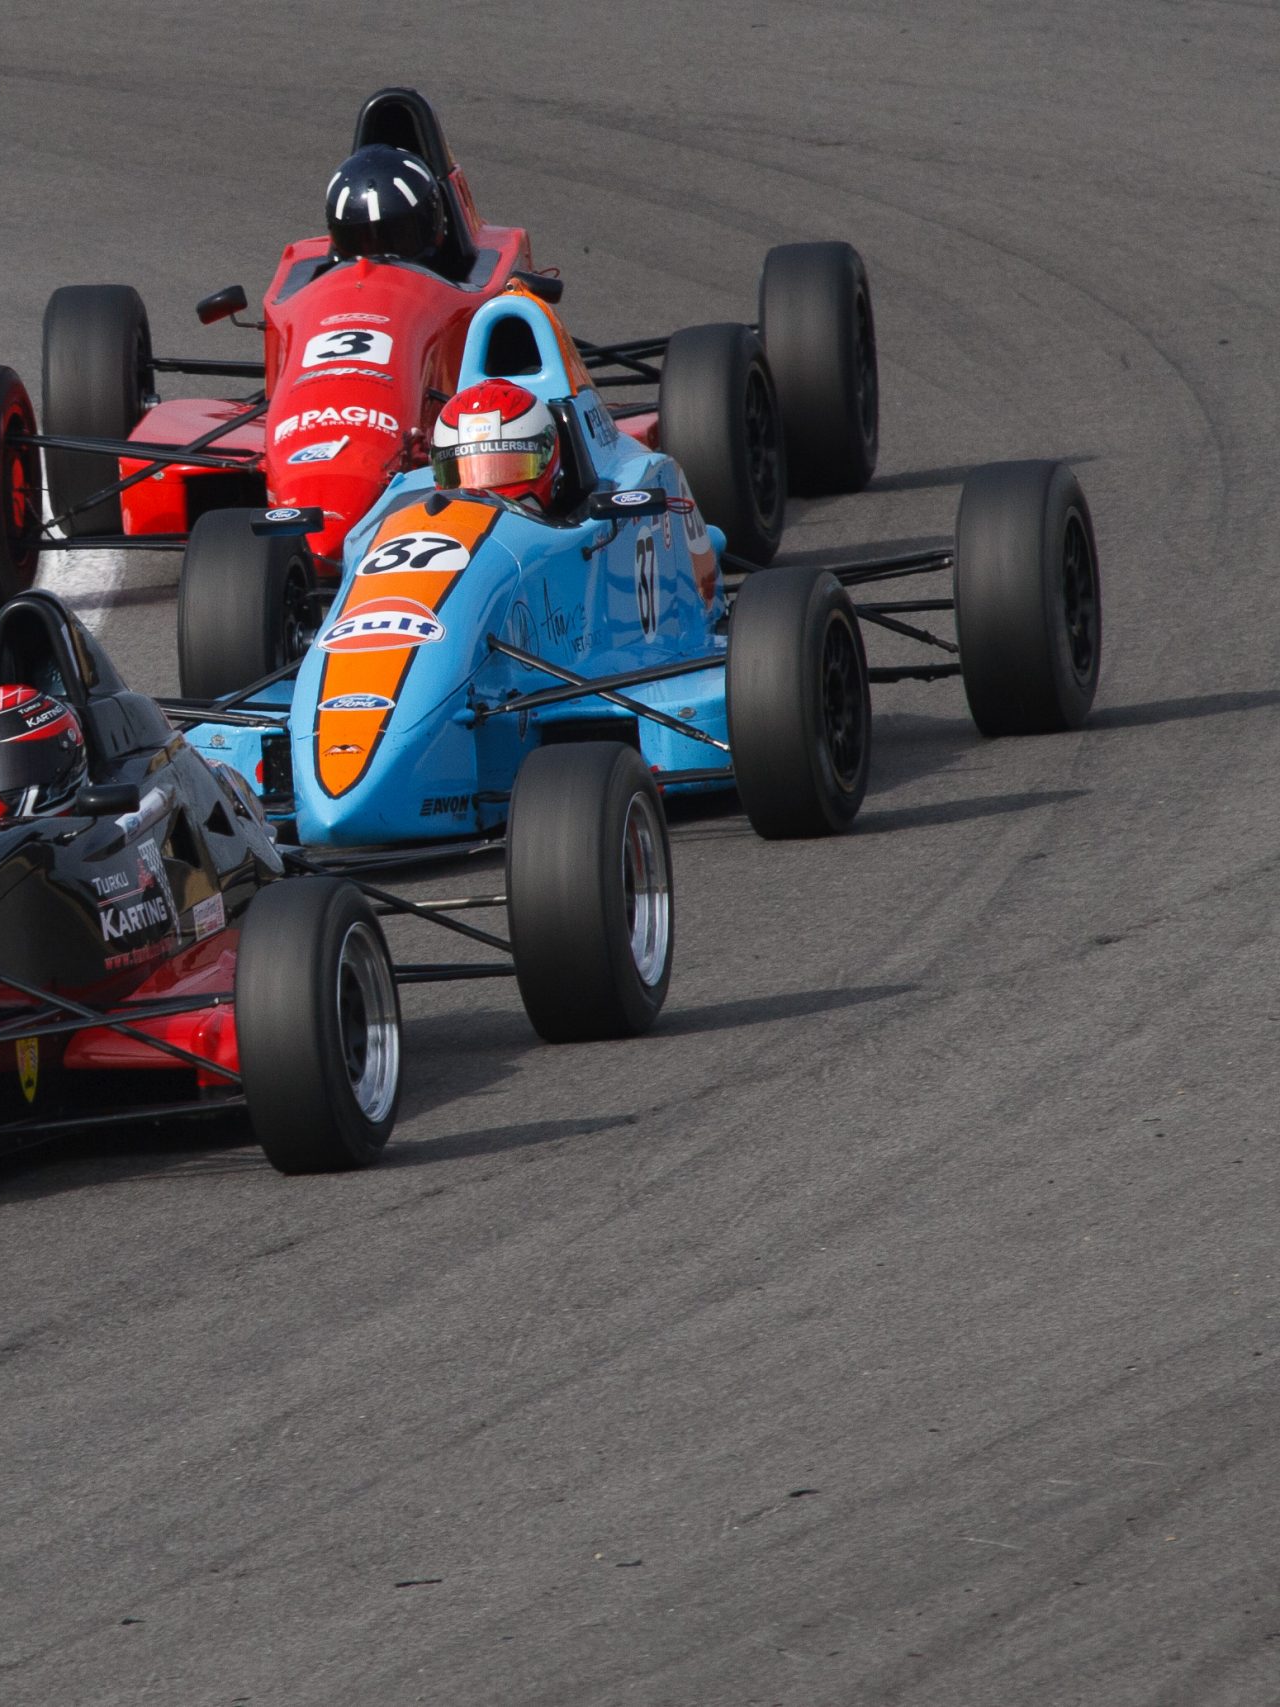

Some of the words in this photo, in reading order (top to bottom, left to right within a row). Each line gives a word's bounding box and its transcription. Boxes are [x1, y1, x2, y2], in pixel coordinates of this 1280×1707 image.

[316, 331, 374, 358] 3
[301, 406, 399, 431] PAGID
[480, 441, 538, 453] ULLERSLEV
[620, 494, 642, 503] Ford
[363, 537, 462, 575] 37
[636, 536, 656, 634] 37
[323, 617, 438, 641] Gulf
[333, 696, 377, 708] Ford
[433, 796, 469, 816] AVON
